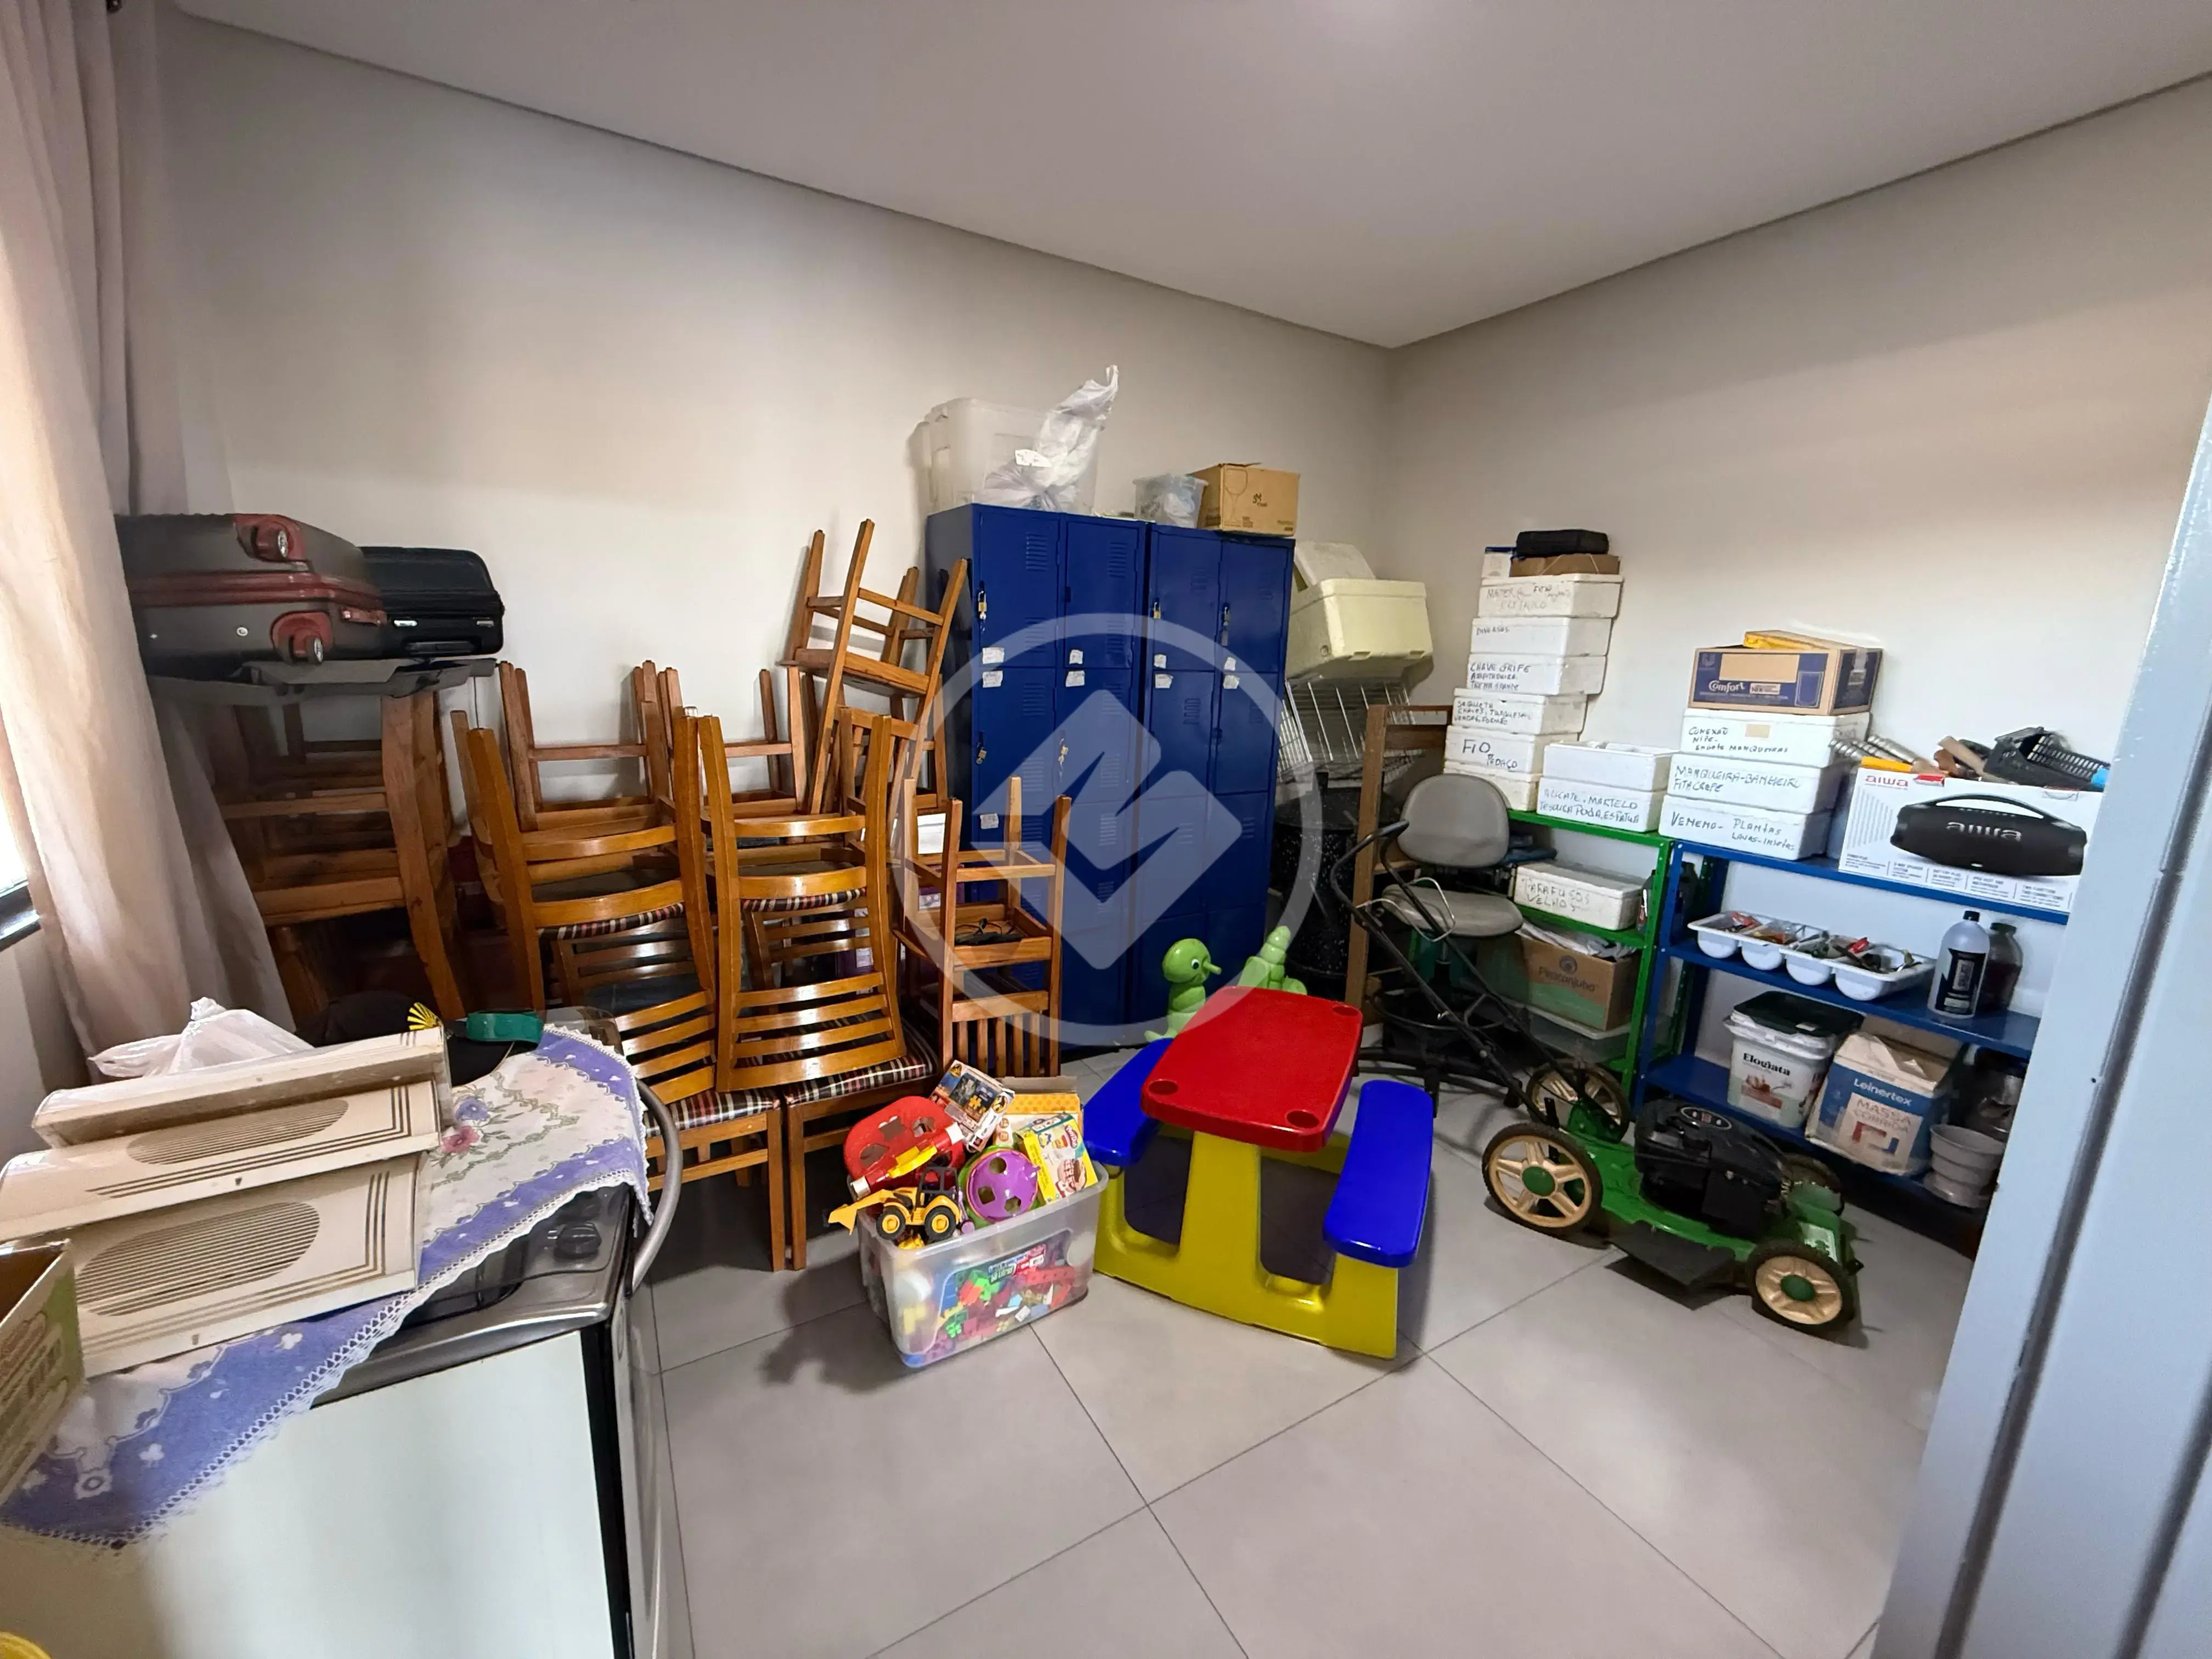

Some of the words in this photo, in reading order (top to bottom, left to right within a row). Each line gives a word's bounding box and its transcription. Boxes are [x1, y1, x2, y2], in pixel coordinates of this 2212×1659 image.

[1470, 662, 1496, 673] CHAVE
[1499, 663, 1531, 673] GRIFE
[1708, 680, 1745, 693] Comfort
[1462, 738, 1491, 754] FIO
[1865, 775, 1909, 787] aiwa
[1945, 821, 2023, 842] aiwa
[1743, 1053, 1791, 1076] Elogiata
[1854, 1077, 1912, 1107] Leinertex
[1857, 1099, 1911, 1126] MASSA
